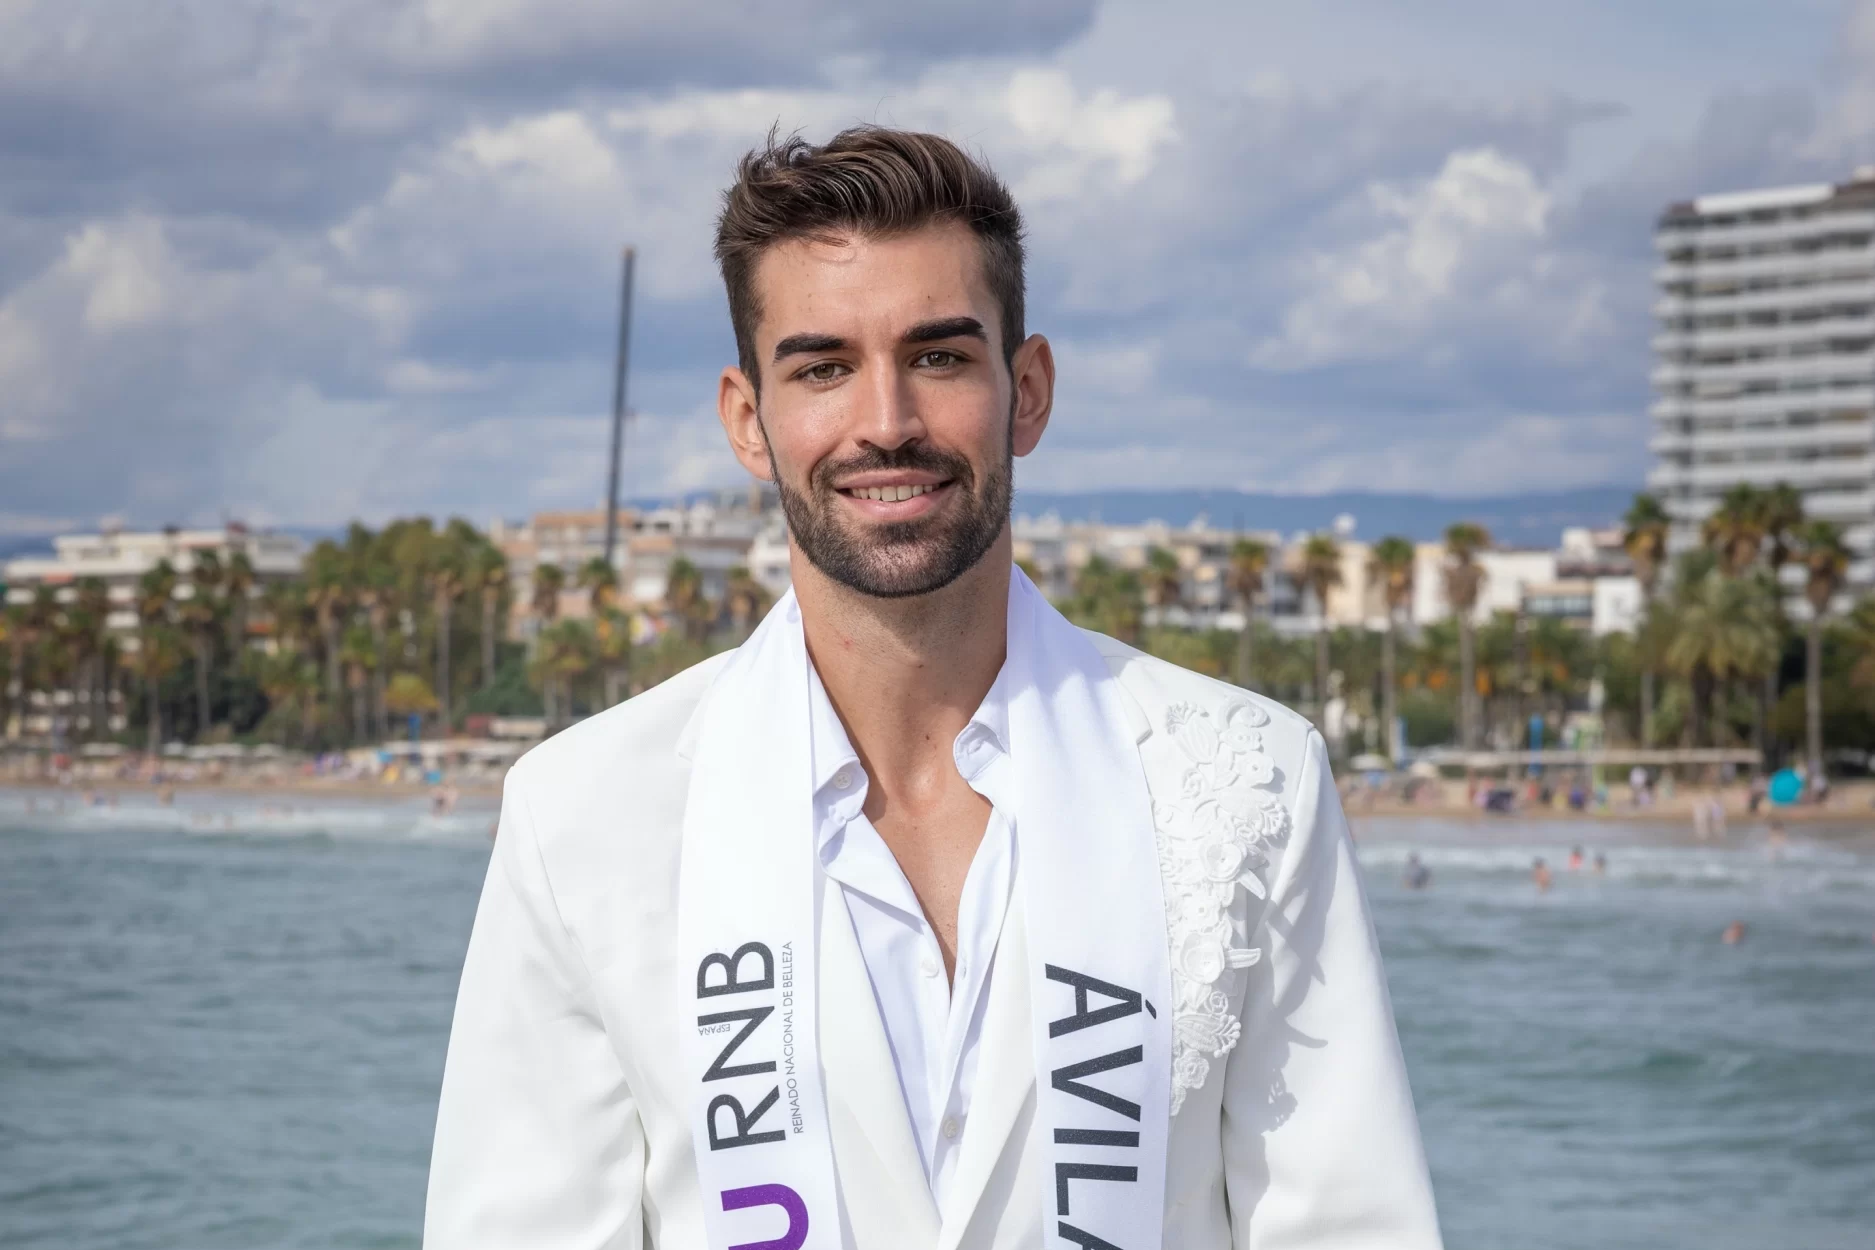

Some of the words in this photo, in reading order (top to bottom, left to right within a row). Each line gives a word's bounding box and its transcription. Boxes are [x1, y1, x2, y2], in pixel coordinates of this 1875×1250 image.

[782, 941, 793, 988] BELLEZA
[782, 990, 793, 1007] DE
[696, 941, 787, 1152] RNB
[698, 1023, 731, 1036] ESPAÑA
[782, 1008, 795, 1075] NACIONAL
[785, 1078, 804, 1134] REINADO
